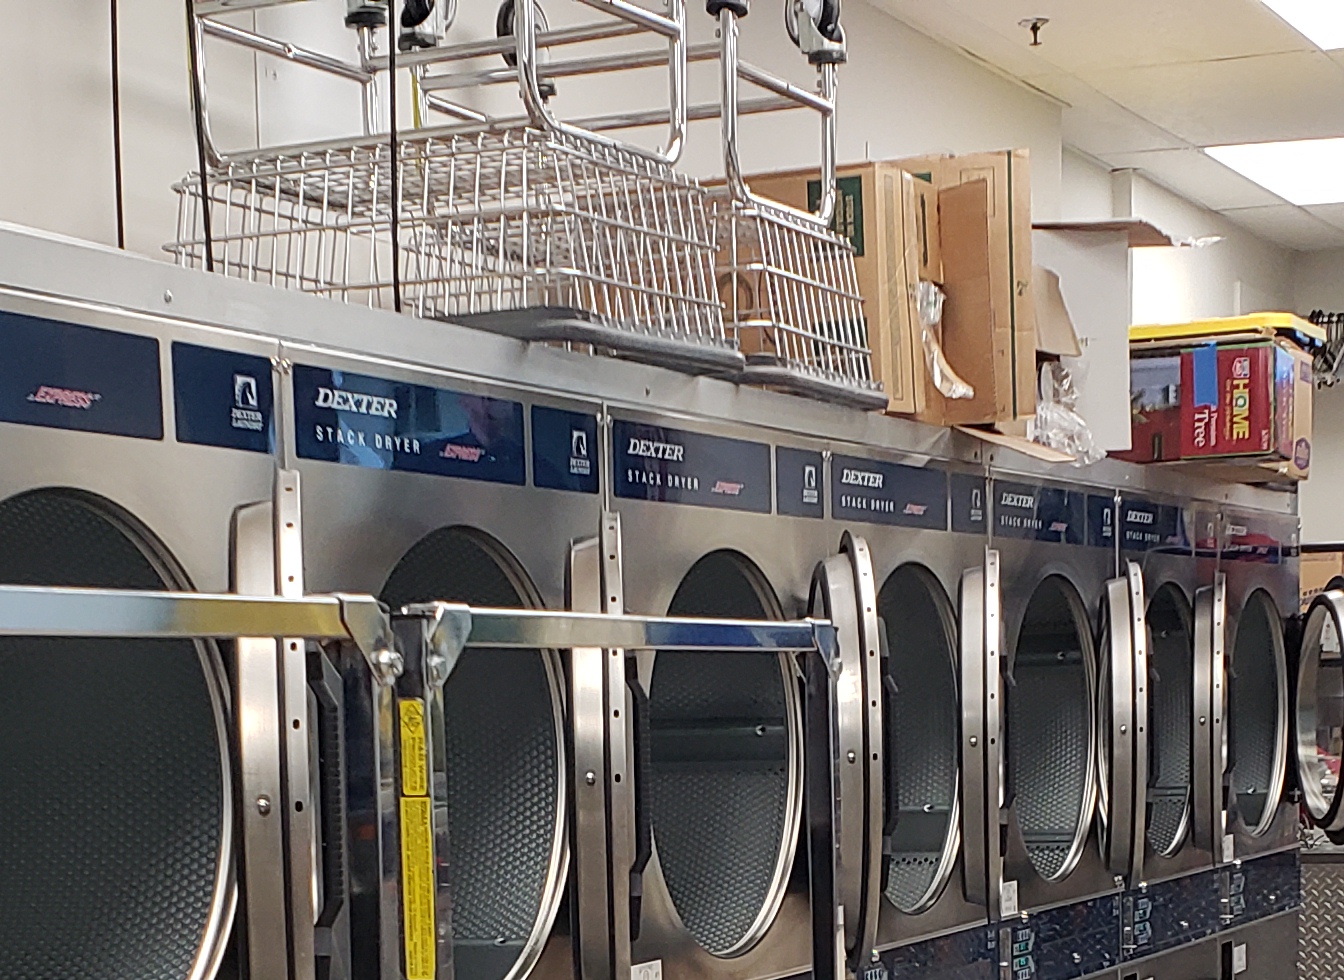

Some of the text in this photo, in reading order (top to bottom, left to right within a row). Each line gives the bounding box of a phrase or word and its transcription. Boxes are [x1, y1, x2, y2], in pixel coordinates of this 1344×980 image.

[314, 386, 398, 419] DEXTER
[315, 424, 366, 447] STACK
[375, 433, 421, 455] DRYER
[1194, 409, 1209, 447] Tree
[627, 437, 684, 462] DEXTER
[628, 468, 662, 486] STACK
[668, 473, 699, 491] DRYER
[841, 468, 884, 489] DEXTER
[1001, 491, 1034, 509] DEXTER
[1126, 509, 1154, 525] DEXTER
